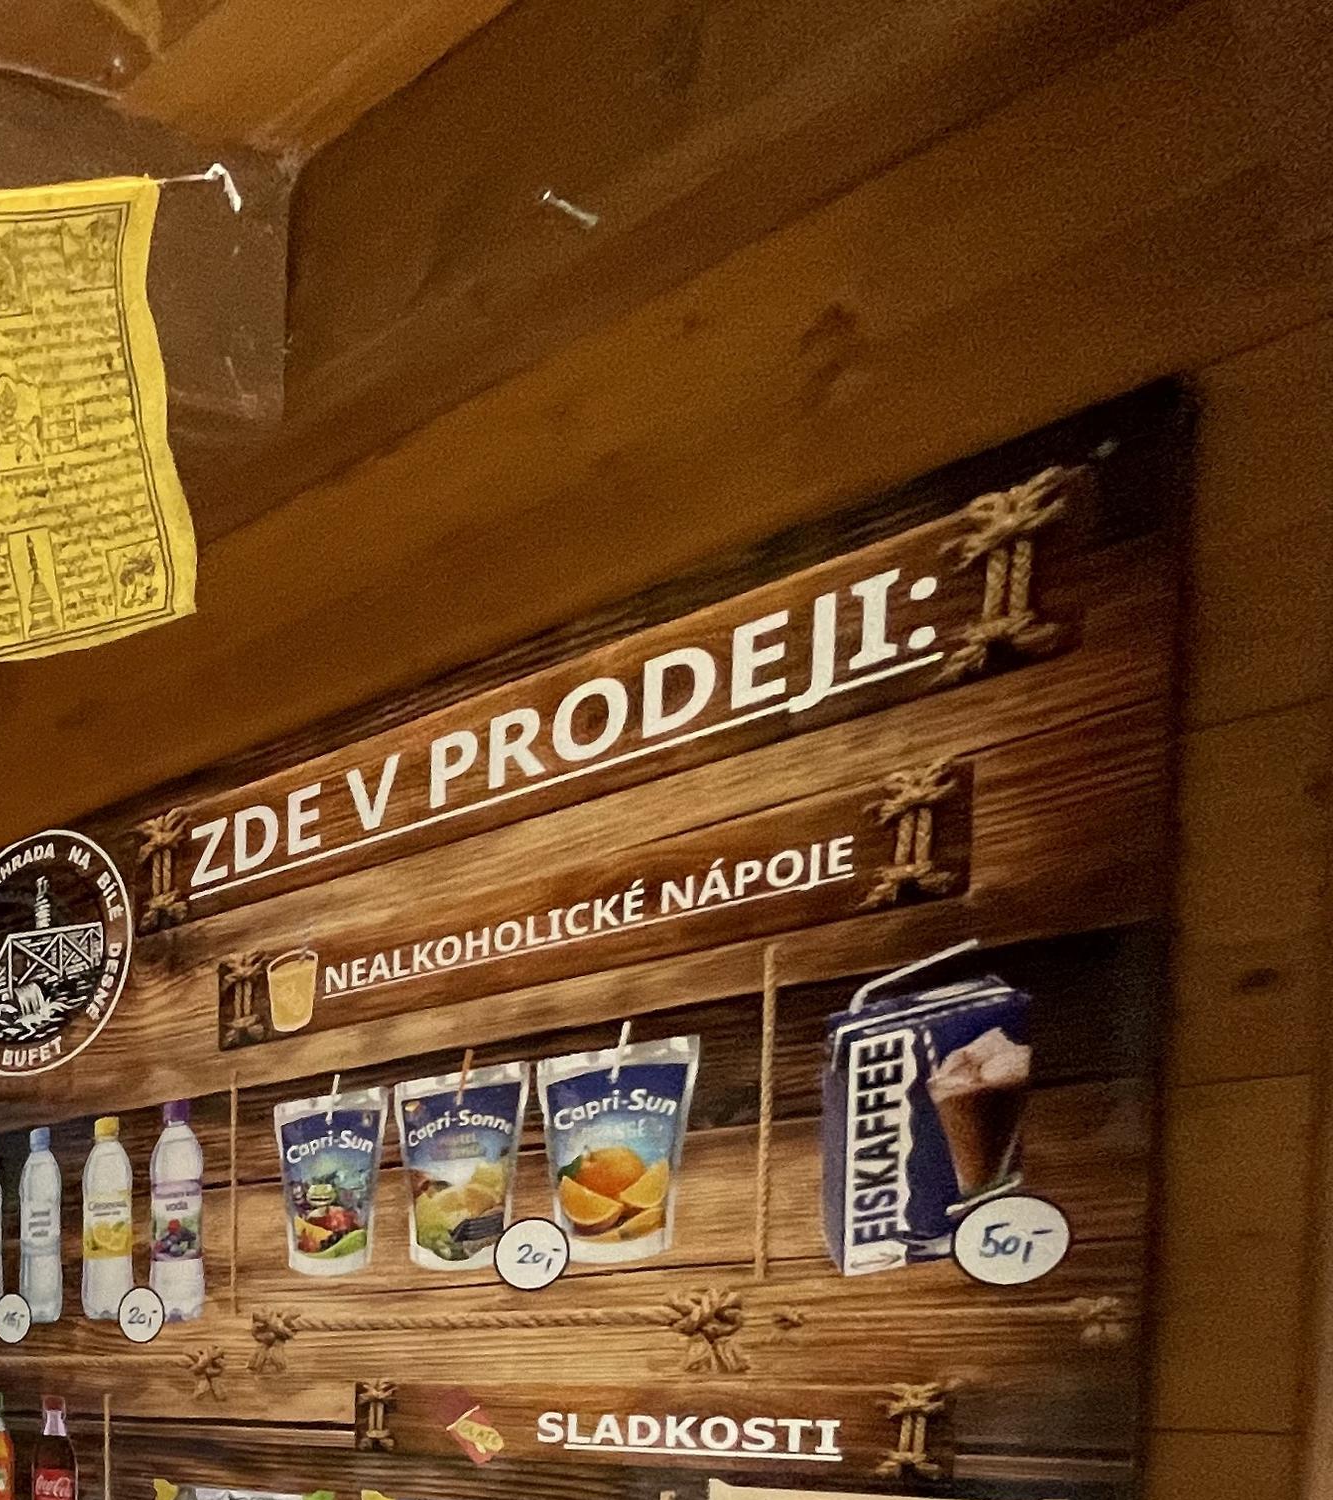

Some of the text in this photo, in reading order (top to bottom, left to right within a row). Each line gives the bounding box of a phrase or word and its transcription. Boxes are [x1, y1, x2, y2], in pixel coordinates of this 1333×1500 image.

[187, 566, 942, 890] ZDE V PRODEJI:
[67, 843, 92, 871] NA
[95, 870, 126, 922] BÍLÉ
[323, 834, 855, 998] NEALKOHOLICKÉ NÁPOJE
[84, 941, 123, 1022] DESNÉ
[1, 1036, 64, 1068] BUFET
[407, 1108, 514, 1150] Capri-Sonne
[552, 1088, 678, 1132] Capri-Sun
[285, 1129, 375, 1166] Capri-Sun
[852, 1036, 906, 1248] EISKAFFEE
[979, 1221, 1054, 1265] 50,-
[536, 1411, 842, 1455] SLADKOSTI
